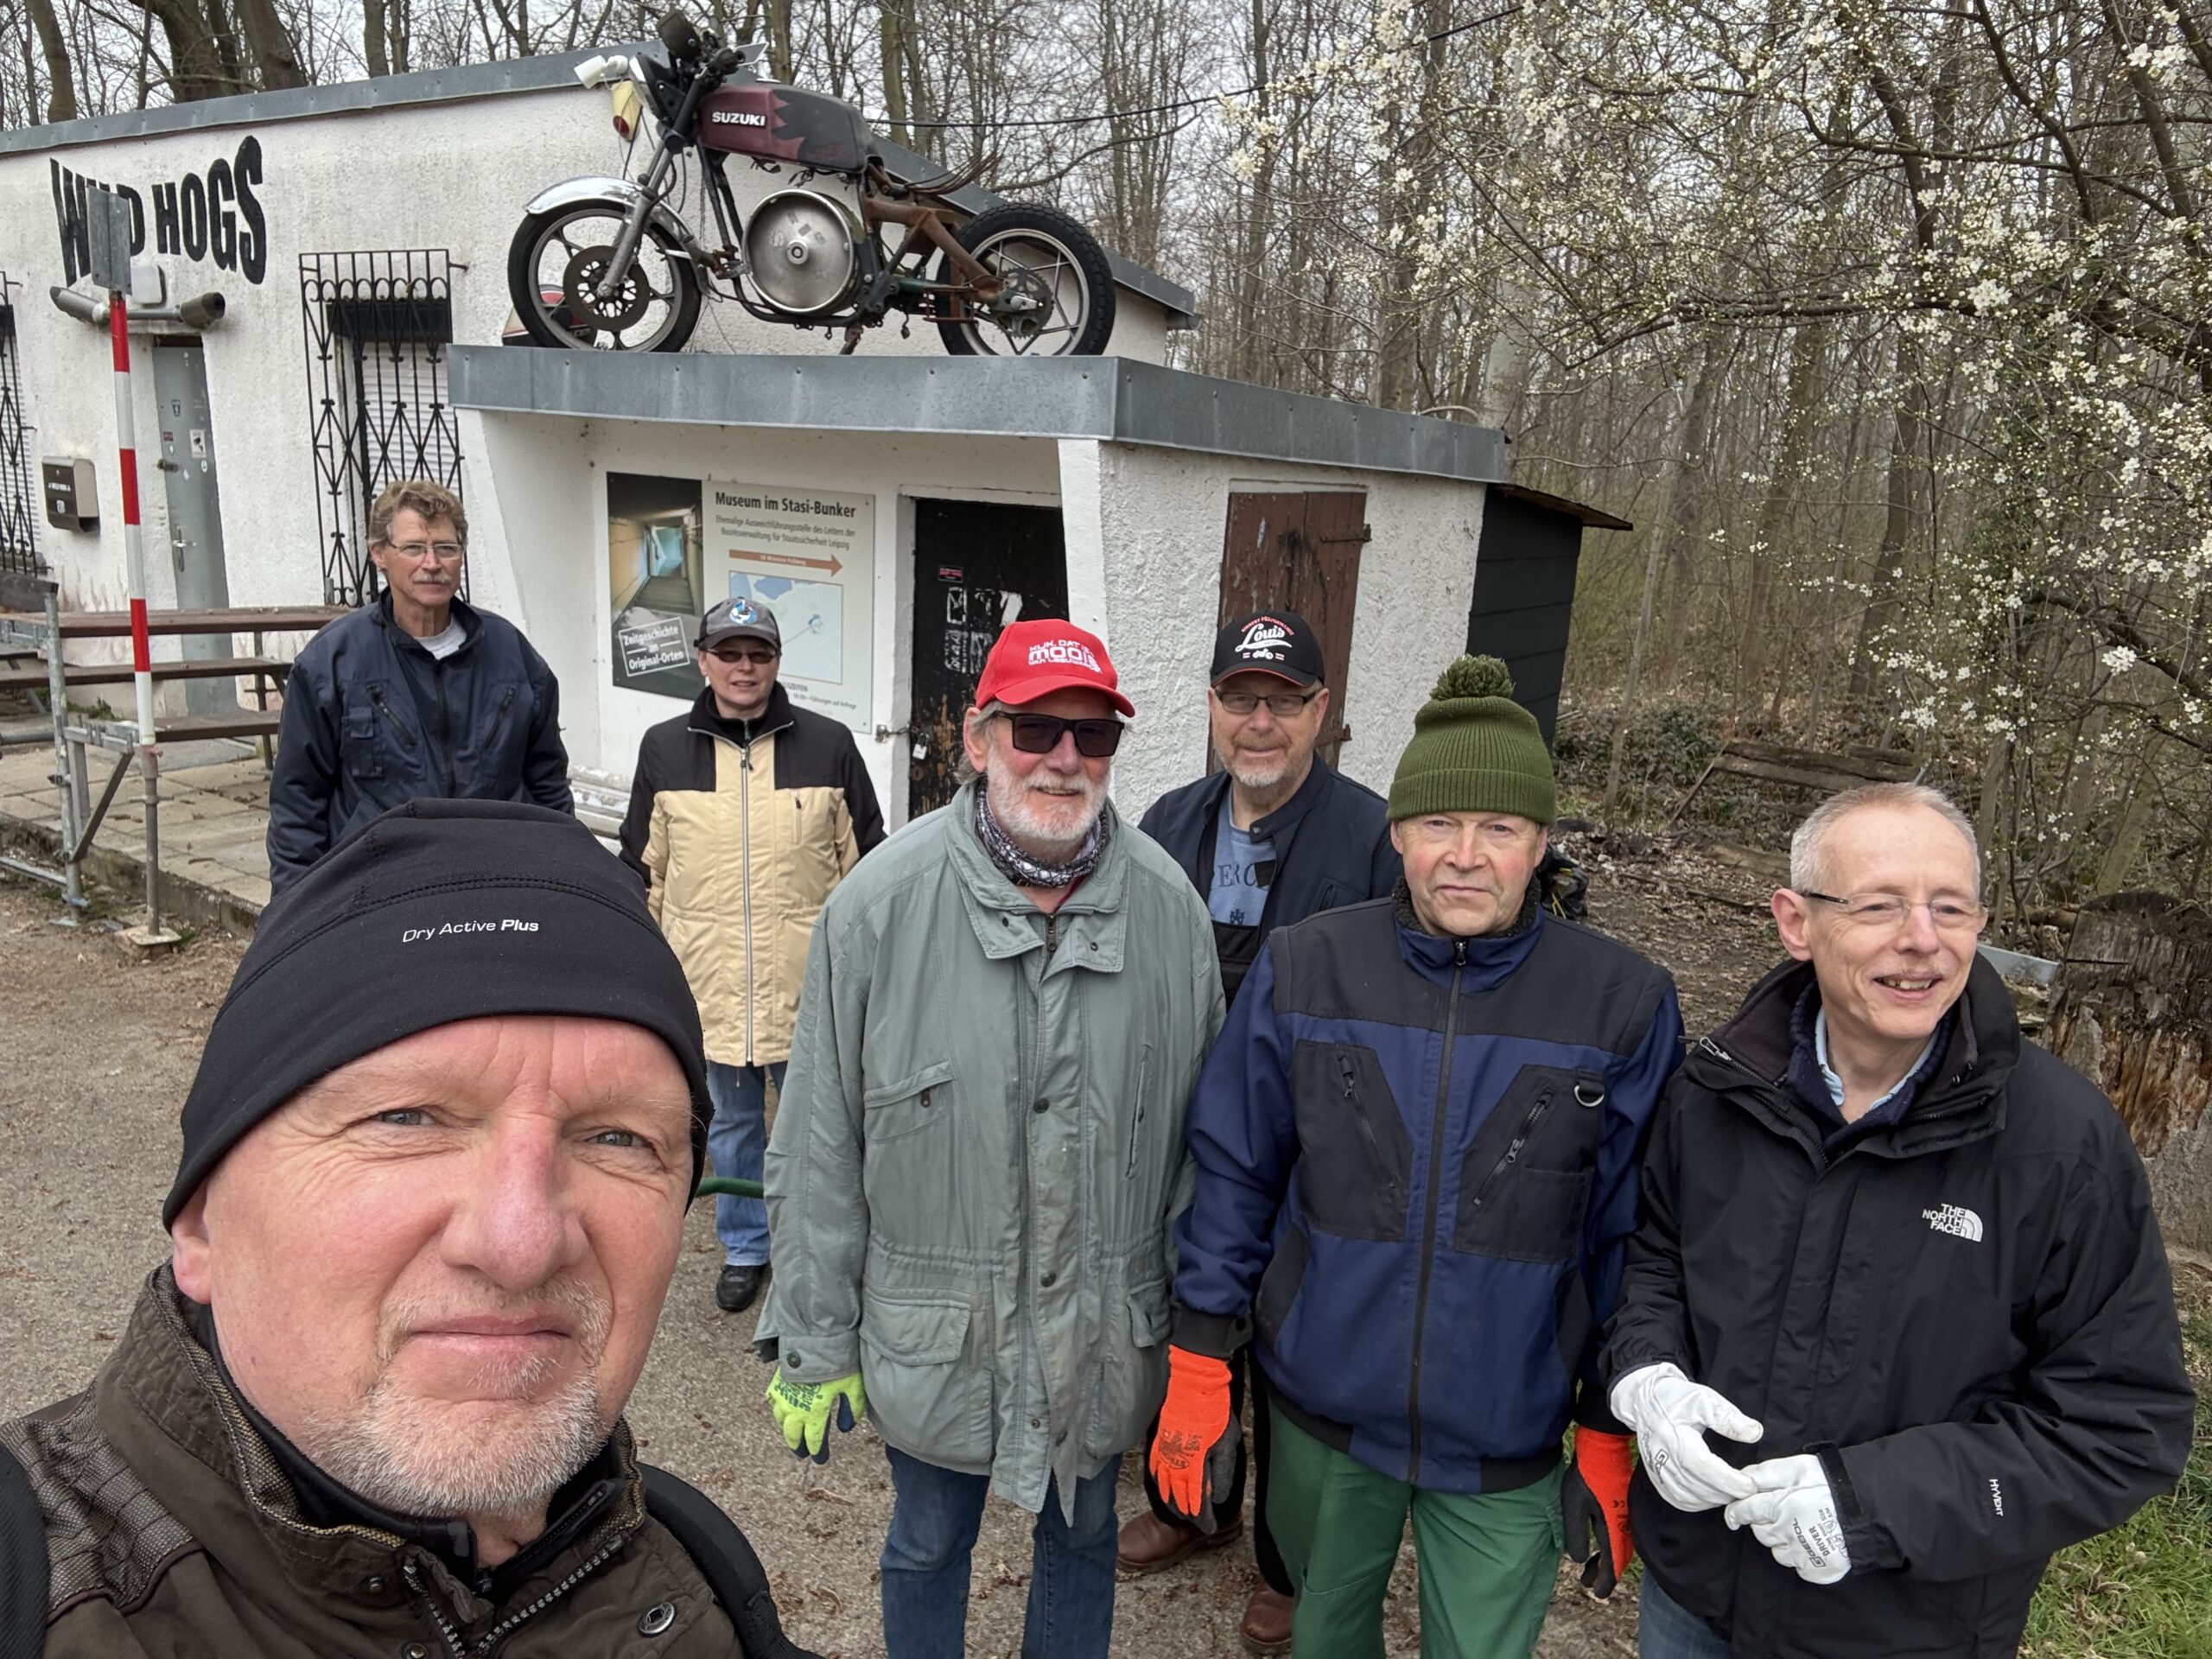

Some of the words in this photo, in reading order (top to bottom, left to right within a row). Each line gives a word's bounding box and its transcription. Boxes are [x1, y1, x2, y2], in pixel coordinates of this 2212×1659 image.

[712, 111, 766, 126] SUZUKI
[50, 157, 145, 288] WD
[151, 135, 267, 284] HOGS
[715, 492, 761, 509] Museum
[765, 495, 779, 511] im
[782, 498, 856, 518] Stasi-Bunker
[845, 529, 856, 537] der
[623, 626, 679, 646] Zeitgeschichte
[1235, 623, 1287, 652] Louis
[628, 651, 684, 671] Original-Orten
[402, 927, 435, 943] Dry
[439, 920, 496, 935] Active
[500, 919, 539, 931] Plus
[1922, 1209, 1962, 1228] NORTH
[1941, 1203, 1966, 1218] THE
[1930, 1220, 1961, 1236] FACE
[1808, 1526, 1831, 1556] DRIVER
